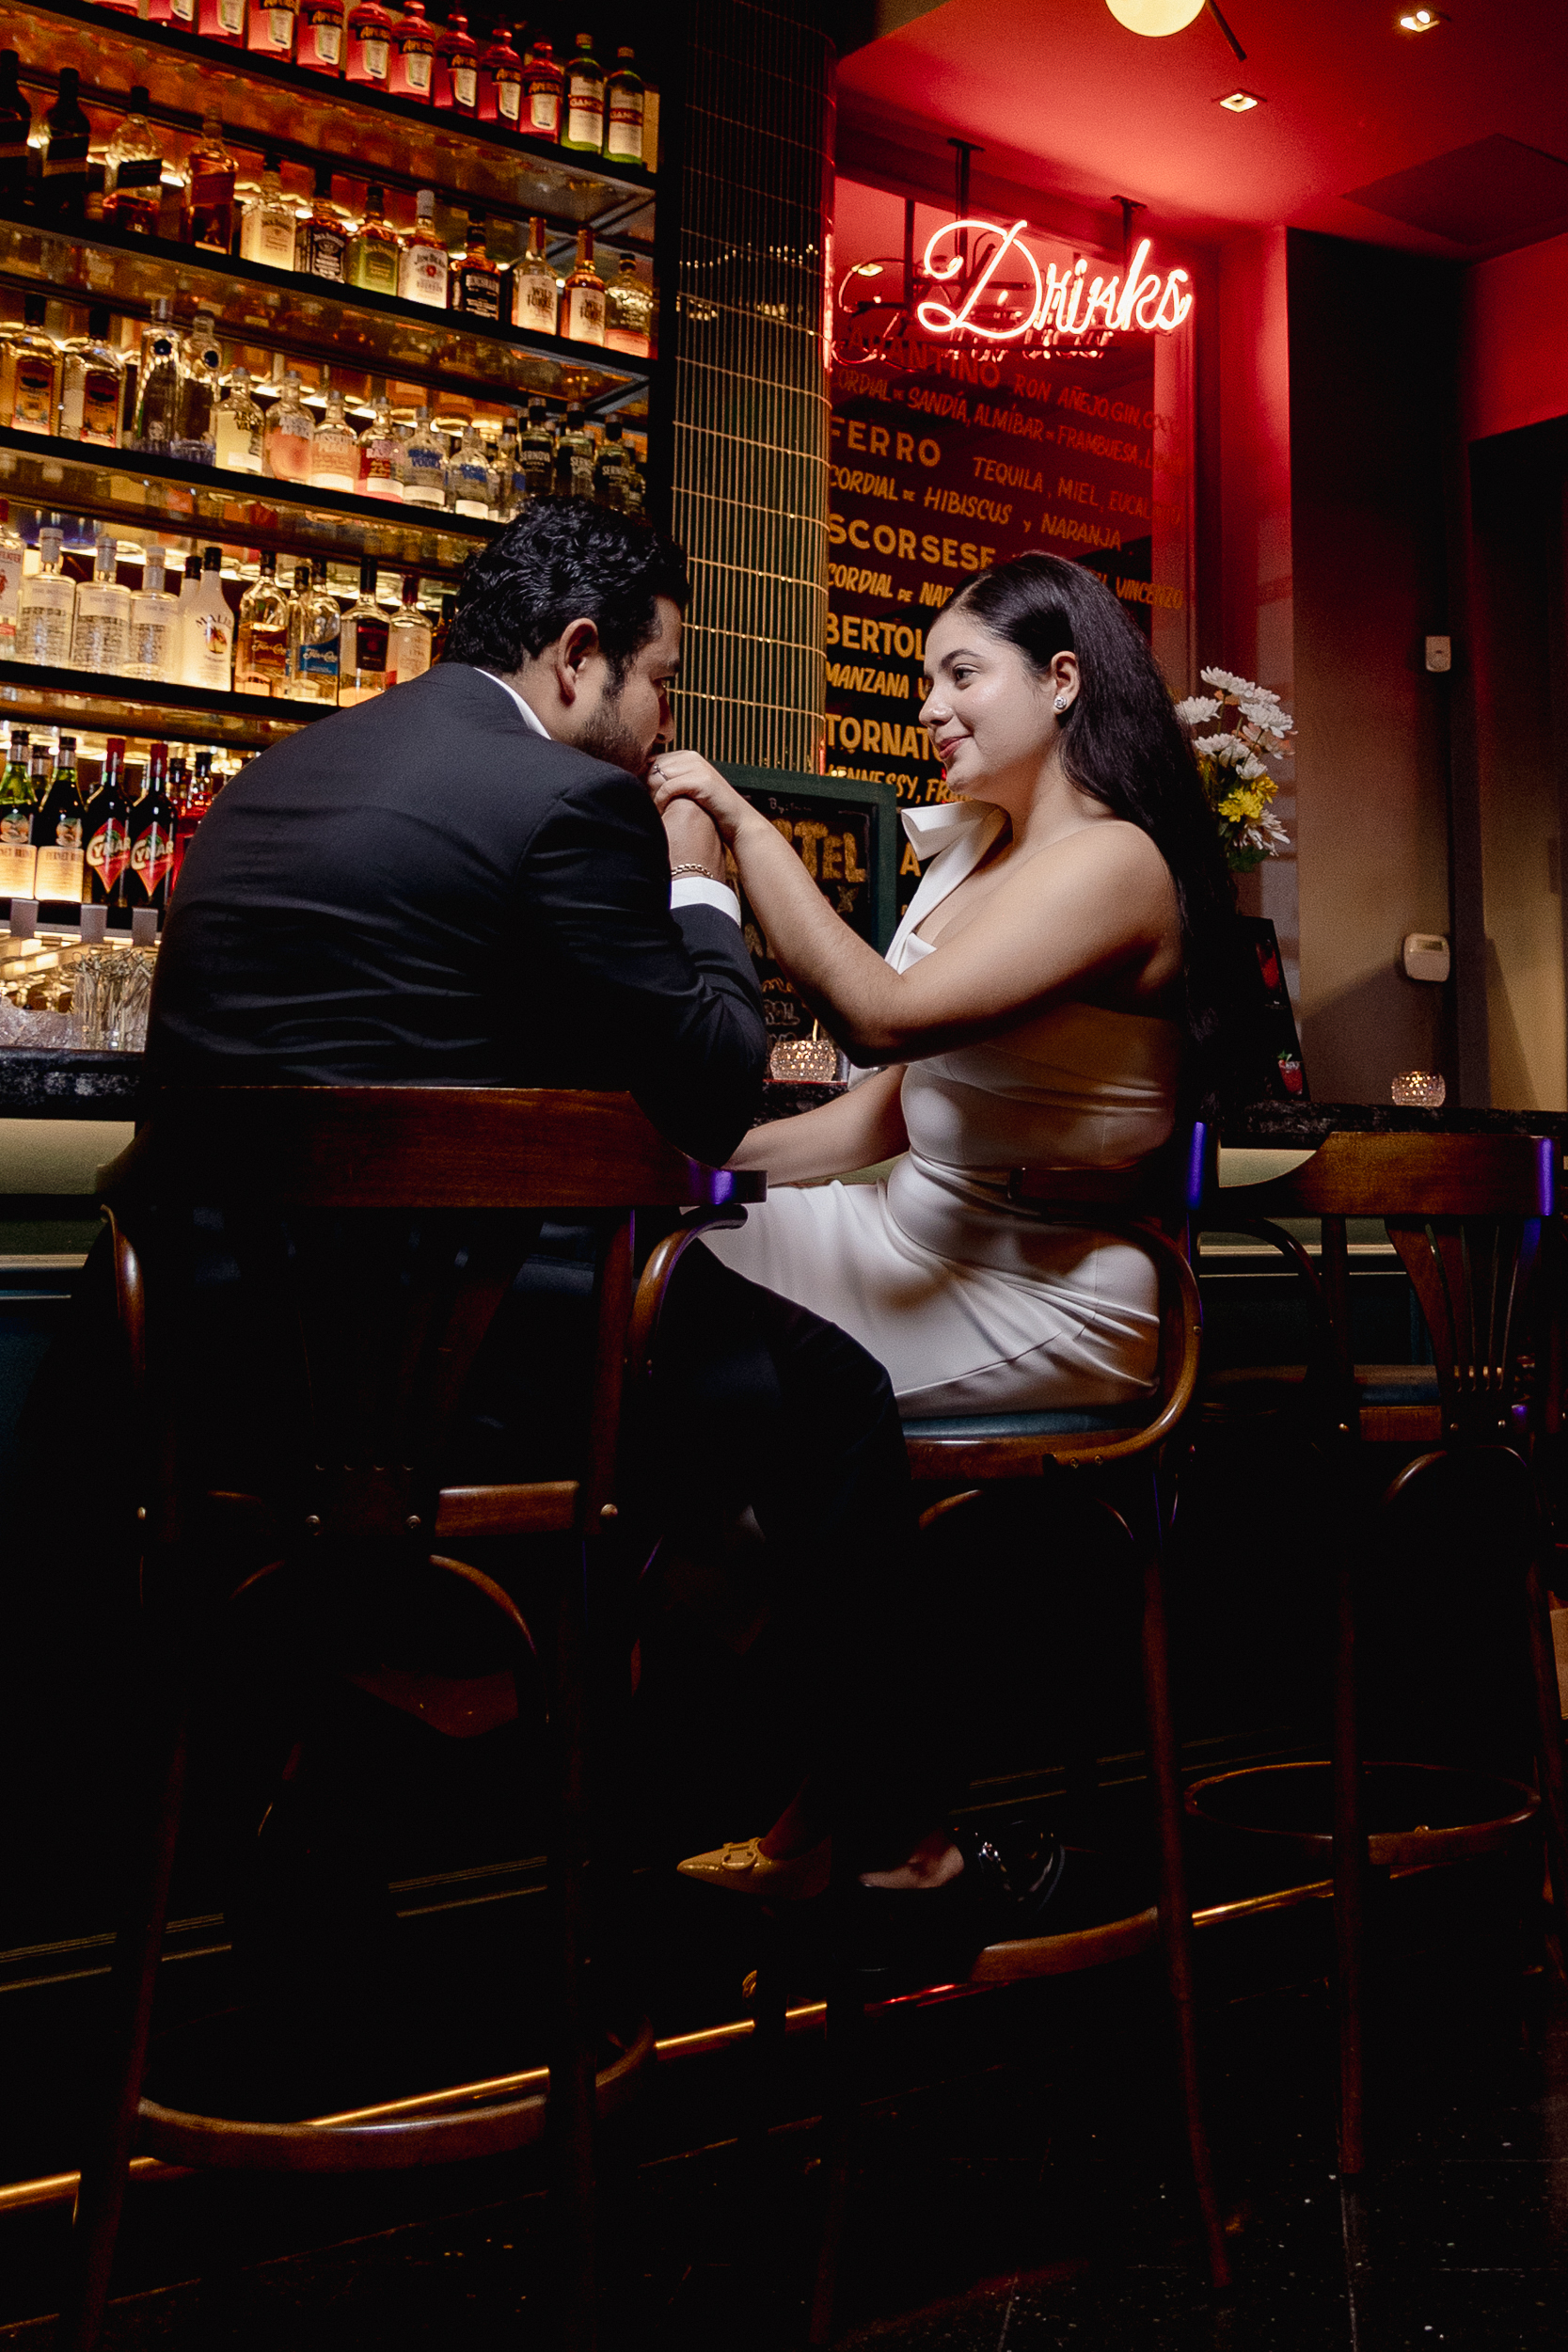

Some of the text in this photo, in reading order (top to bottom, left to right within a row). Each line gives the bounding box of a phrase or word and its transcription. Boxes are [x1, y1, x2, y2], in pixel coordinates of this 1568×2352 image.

[918, 220, 1193, 340] Drinks
[1013, 373, 1052, 403] RON
[831, 416, 942, 468] FERRO
[974, 403, 1043, 442] ALMÍBAR
[830, 464, 898, 501] CORDIAL
[924, 485, 1013, 526] HIBISCUS
[1040, 512, 1121, 551] NARANJA
[828, 513, 997, 572] SCORSESE
[827, 612, 926, 661] BERTOL
[826, 660, 910, 700] MANZANA
